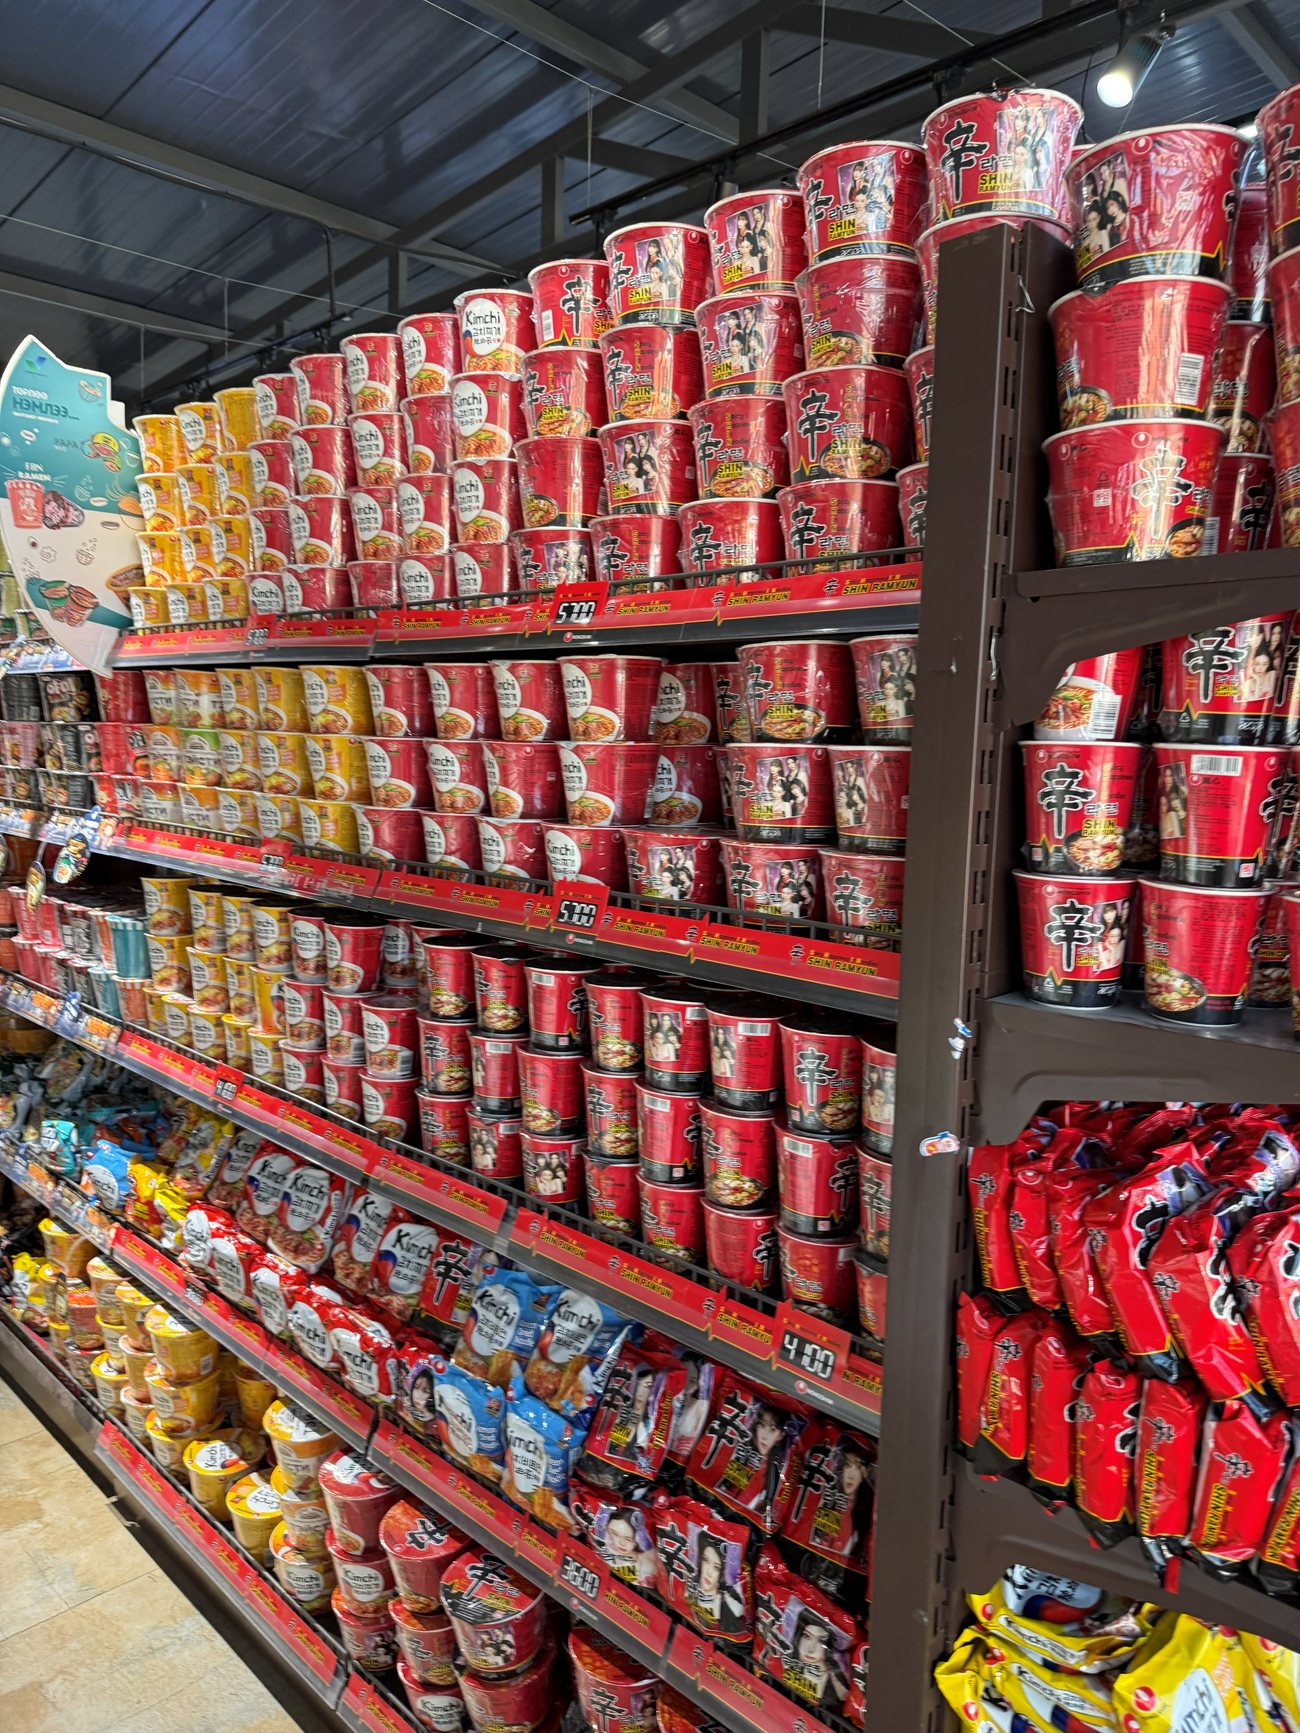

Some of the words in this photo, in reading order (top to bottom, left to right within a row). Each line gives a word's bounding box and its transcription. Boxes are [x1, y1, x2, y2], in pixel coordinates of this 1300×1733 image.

[940, 118, 990, 203] 辛
[979, 173, 1013, 186] SHIN
[829, 218, 856, 234] SHIN
[465, 311, 501, 327] Kimchi
[799, 389, 840, 462] 辛
[718, 463, 744, 473] SHIN
[1131, 443, 1195, 539] 辛
[728, 596, 748, 606] SHIN
[842, 583, 868, 594] SHIN
[872, 579, 918, 592] RAMYUN
[1182, 626, 1248, 703] 辛
[768, 705, 795, 715] SHIN
[1037, 763, 1097, 838] 辛
[701, 937, 721, 947] SHIN
[1044, 899, 1104, 972] 辛
[808, 956, 831, 967] SHIN
[834, 962, 878, 976] RAMYUN
[794, 1047, 839, 1107] 辛
[391, 1228, 434, 1260] Kimch
[432, 1240, 473, 1306] 辛
[476, 1290, 517, 1326] Kimchi
[555, 1299, 600, 1331] Kimchi
[597, 1362, 634, 1440] 辛
[701, 1389, 753, 1470] 辛
[792, 1438, 838, 1523] 辛
